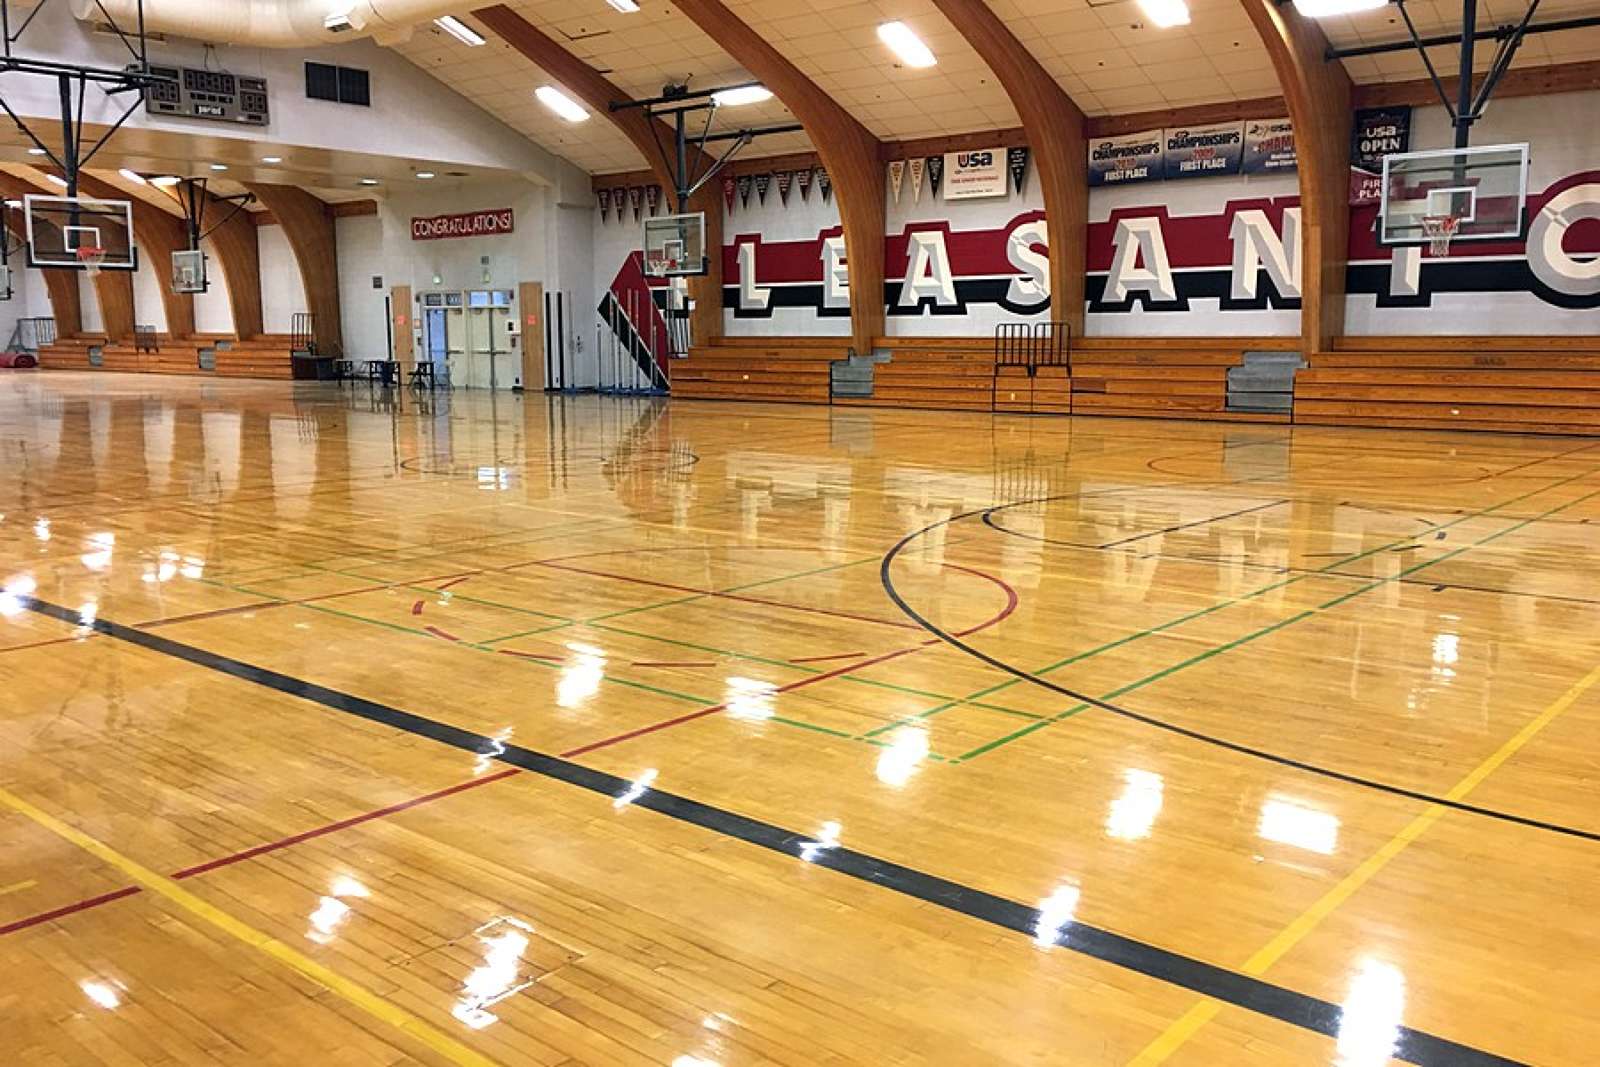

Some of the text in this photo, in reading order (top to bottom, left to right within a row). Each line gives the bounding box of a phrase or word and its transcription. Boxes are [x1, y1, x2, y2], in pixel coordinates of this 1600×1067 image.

[1167, 131, 1240, 150] CHAMPIONSHIPS
[1361, 137, 1400, 152] OPEN
[1093, 142, 1160, 160] CHAMPIONSHIPS
[1180, 158, 1226, 172] FIRST PLACE
[1104, 167, 1148, 182] FIRST PLACE
[413, 213, 511, 235] CONGRATULATIONS!
